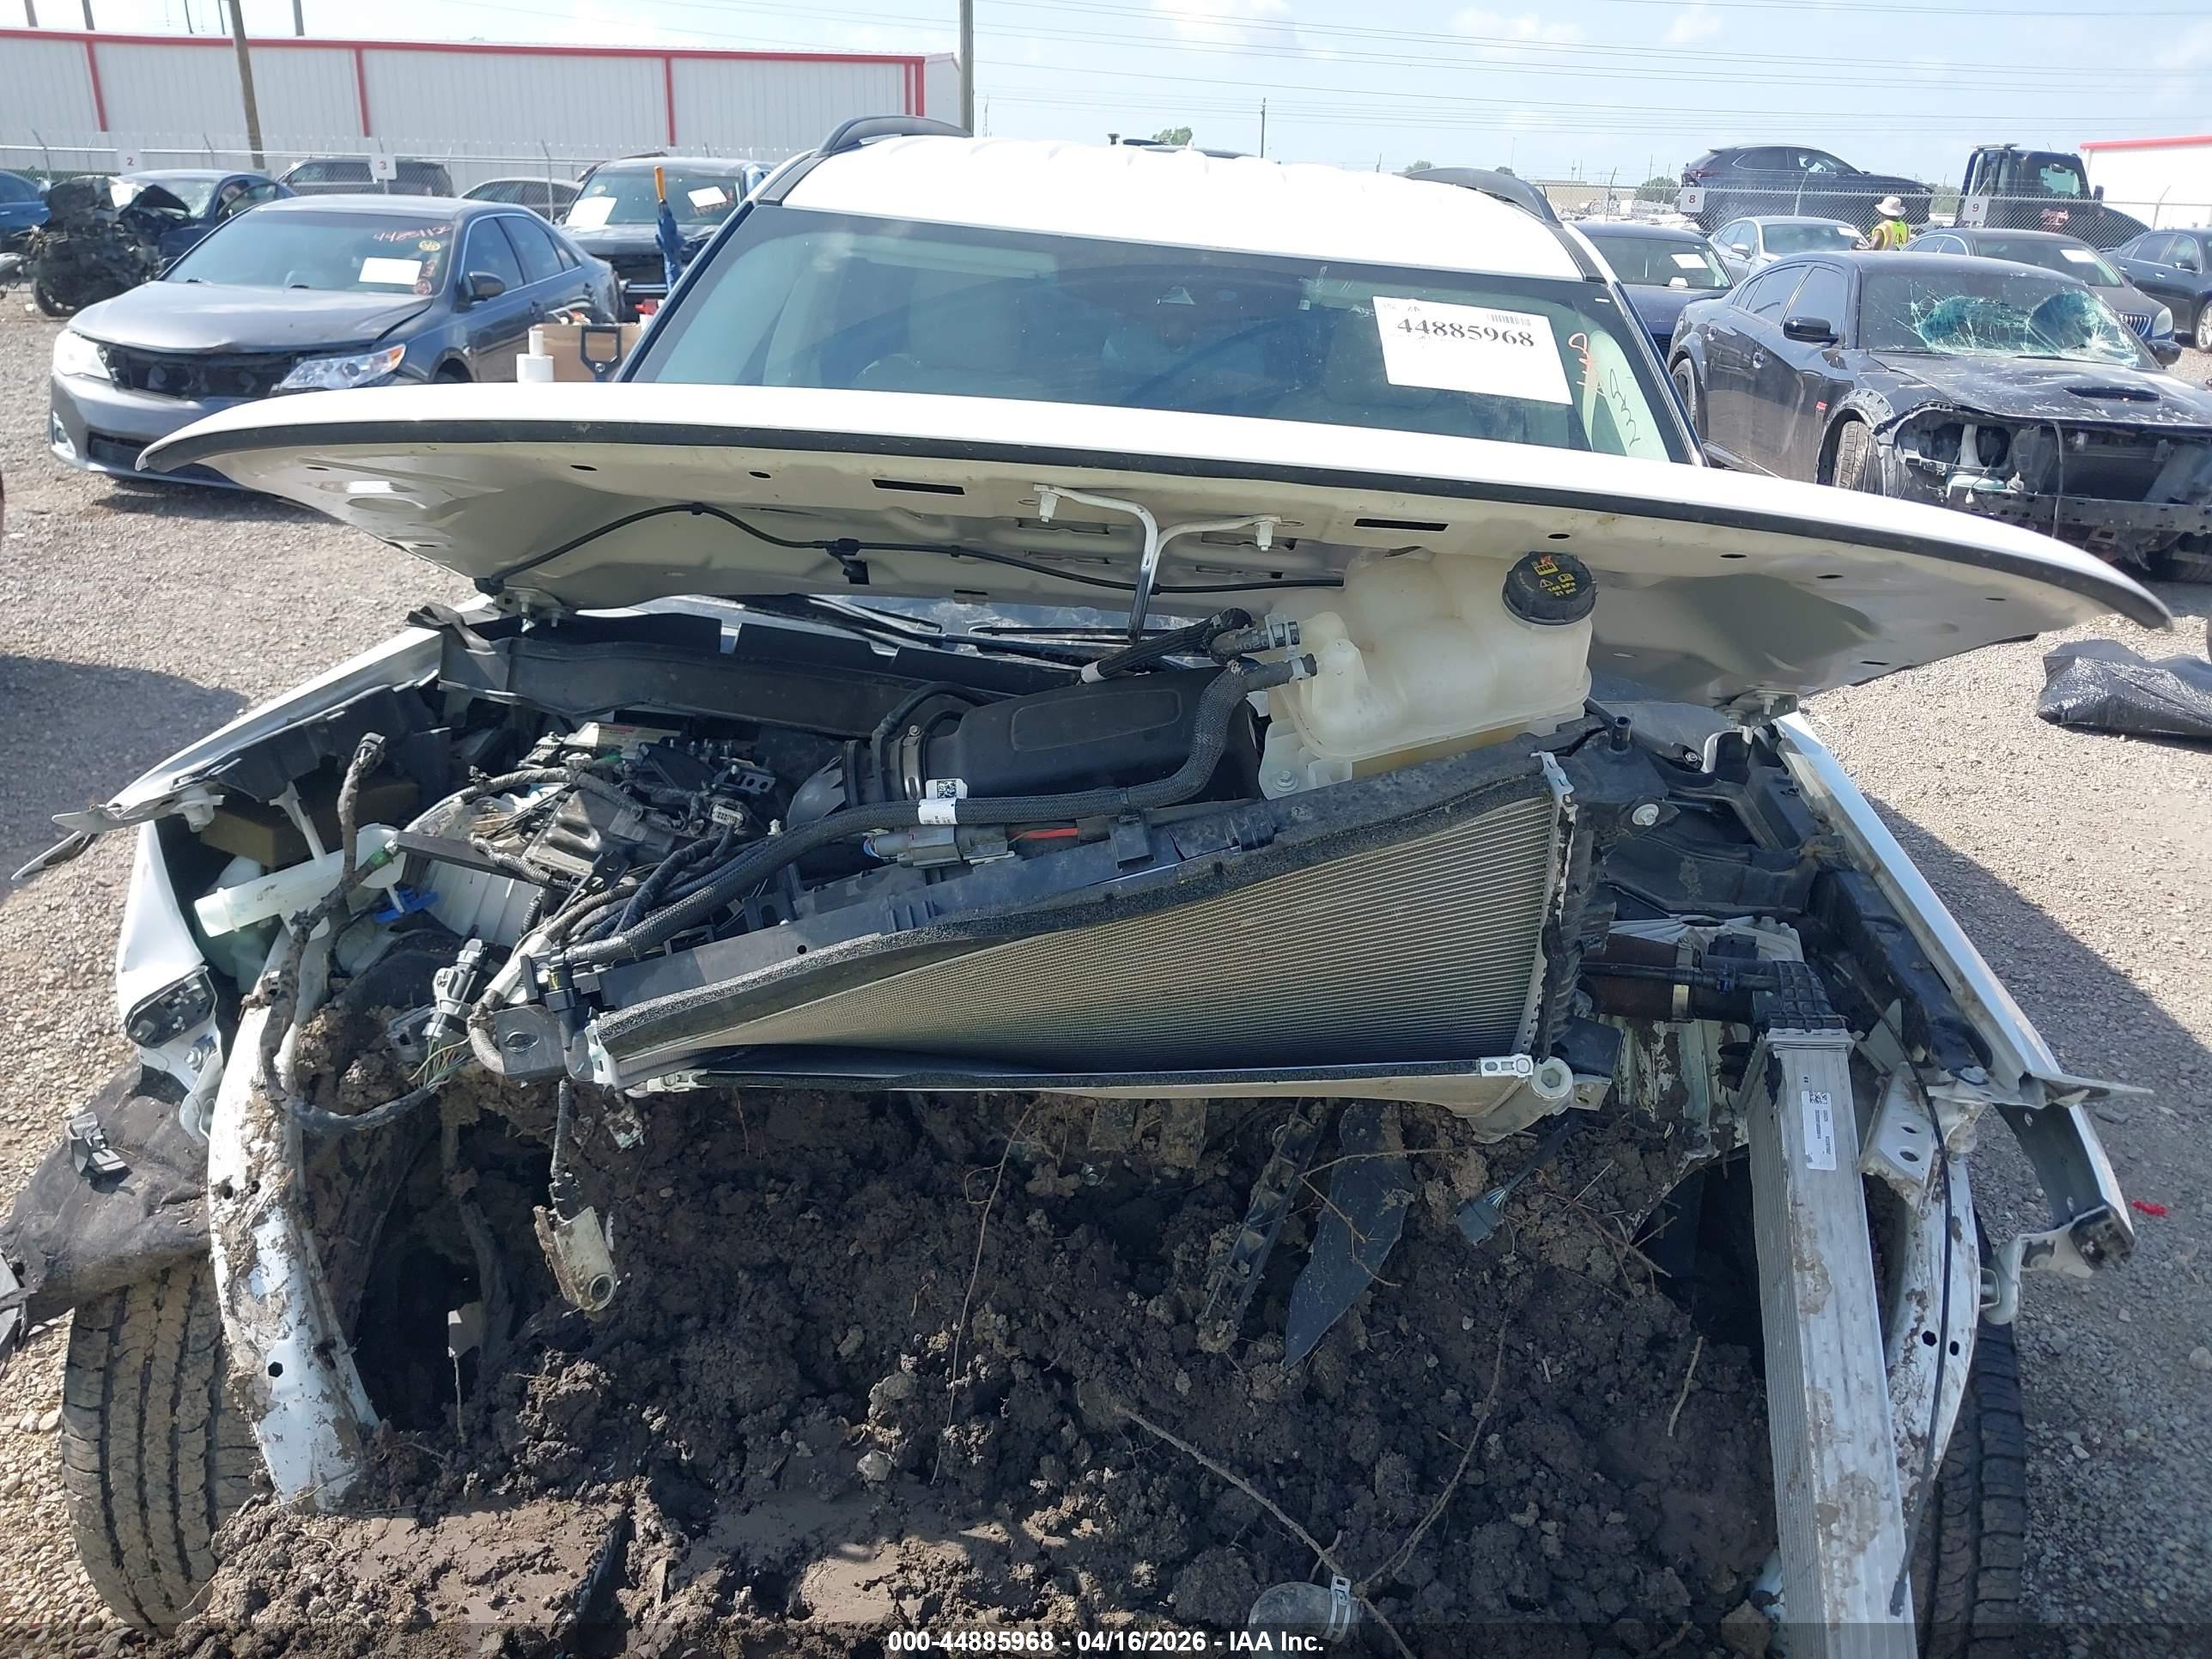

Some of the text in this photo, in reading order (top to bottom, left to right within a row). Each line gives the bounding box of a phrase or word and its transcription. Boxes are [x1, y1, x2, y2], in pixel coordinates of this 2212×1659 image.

[1688, 194, 1697, 204] 8
[1972, 203, 1980, 212] 9
[1397, 318, 1535, 347] 44885968
